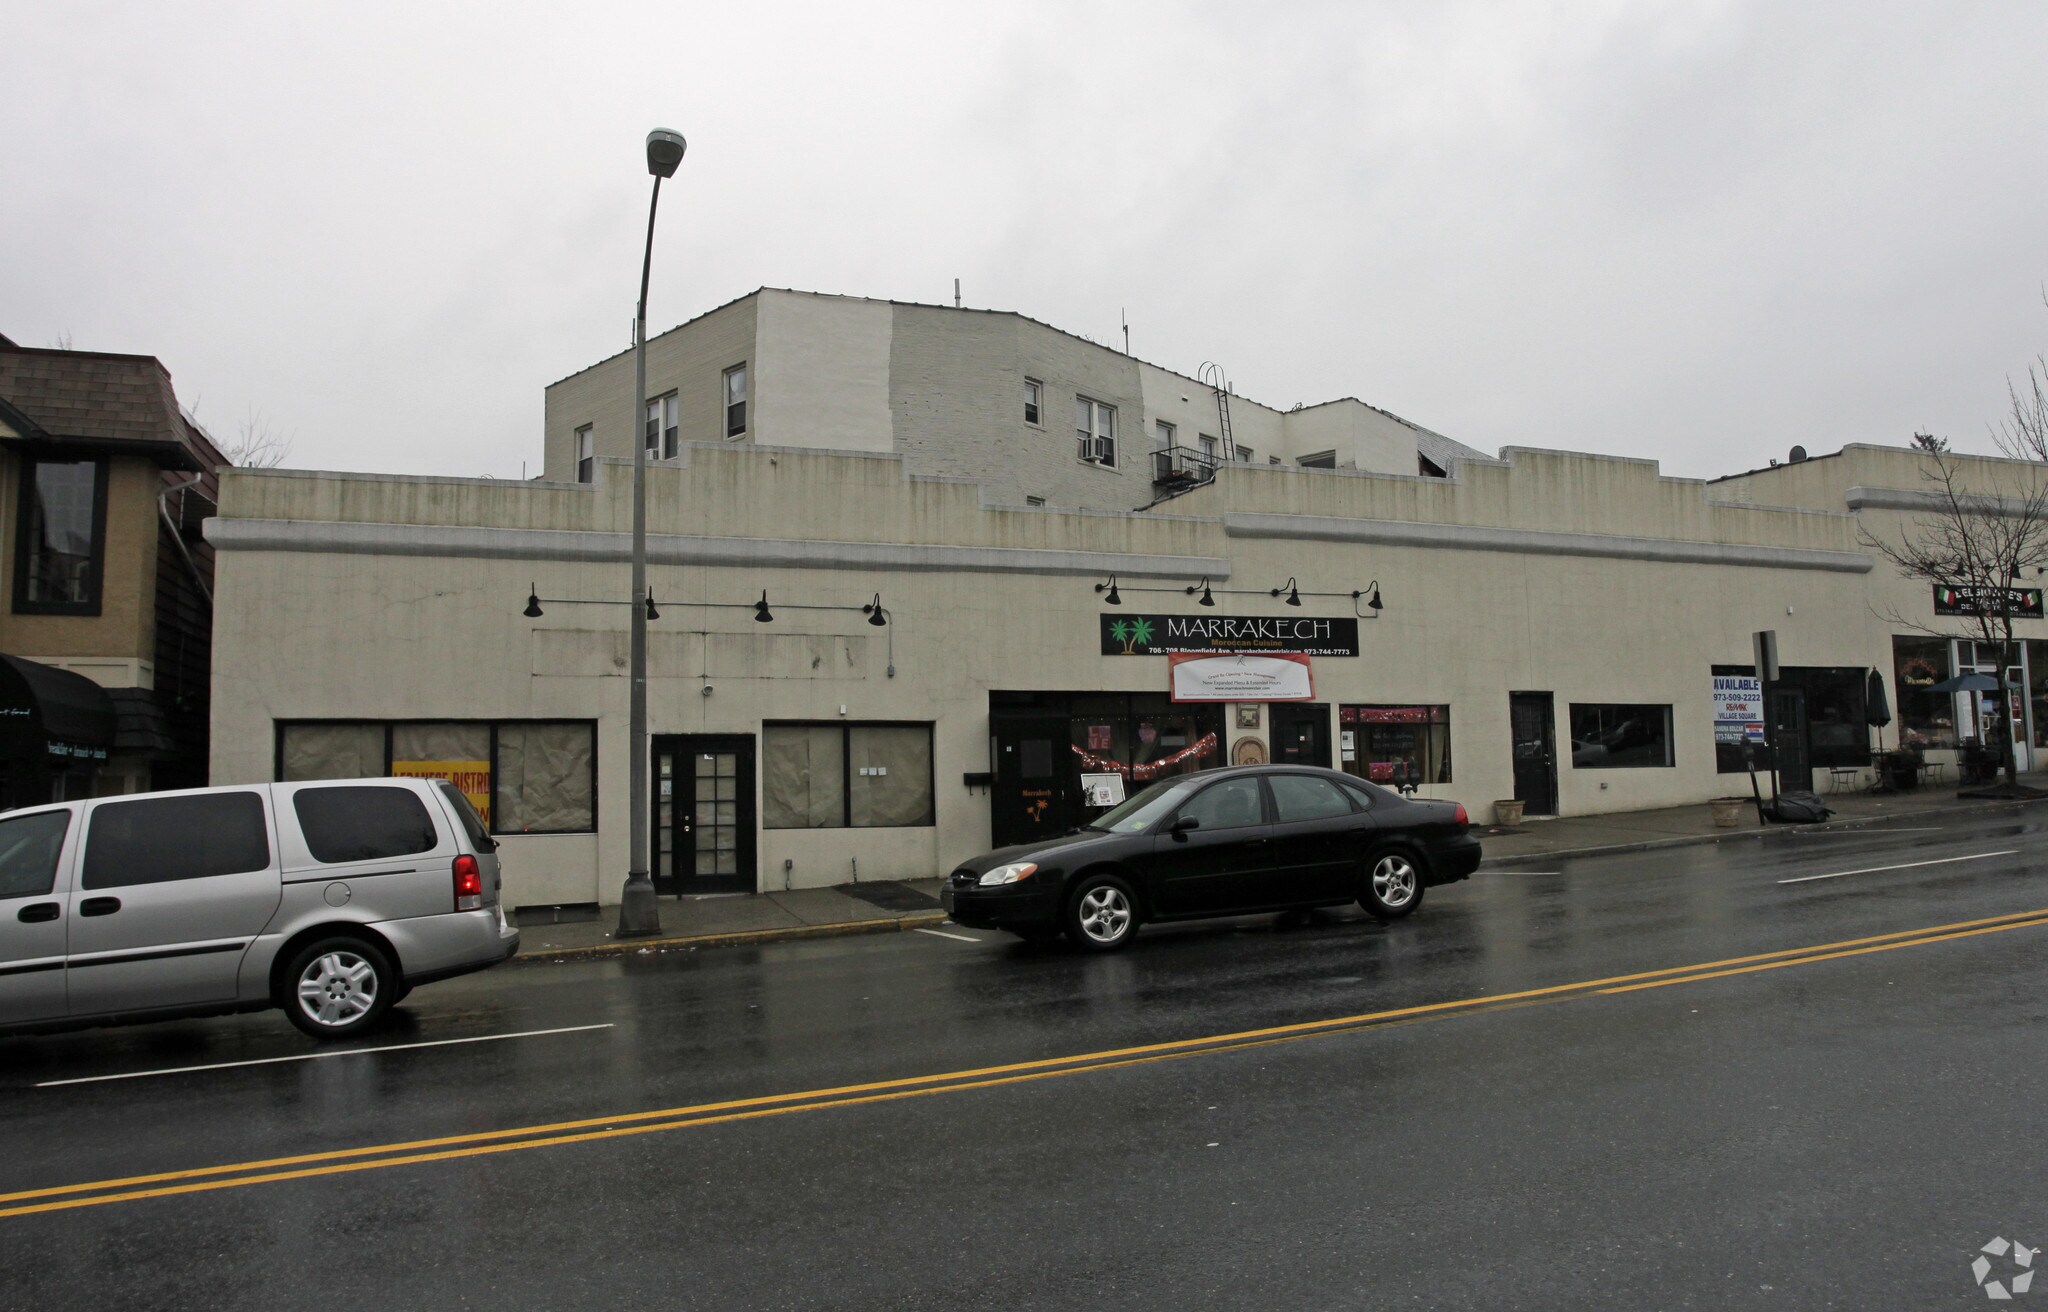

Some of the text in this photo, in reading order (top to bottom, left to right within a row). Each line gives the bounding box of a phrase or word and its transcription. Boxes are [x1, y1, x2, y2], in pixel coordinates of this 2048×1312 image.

[1167, 618, 1331, 640] MARRAKECH
[1211, 639, 1283, 647] Moroccan Cuisine
[1714, 679, 1759, 690] AVAILABLE
